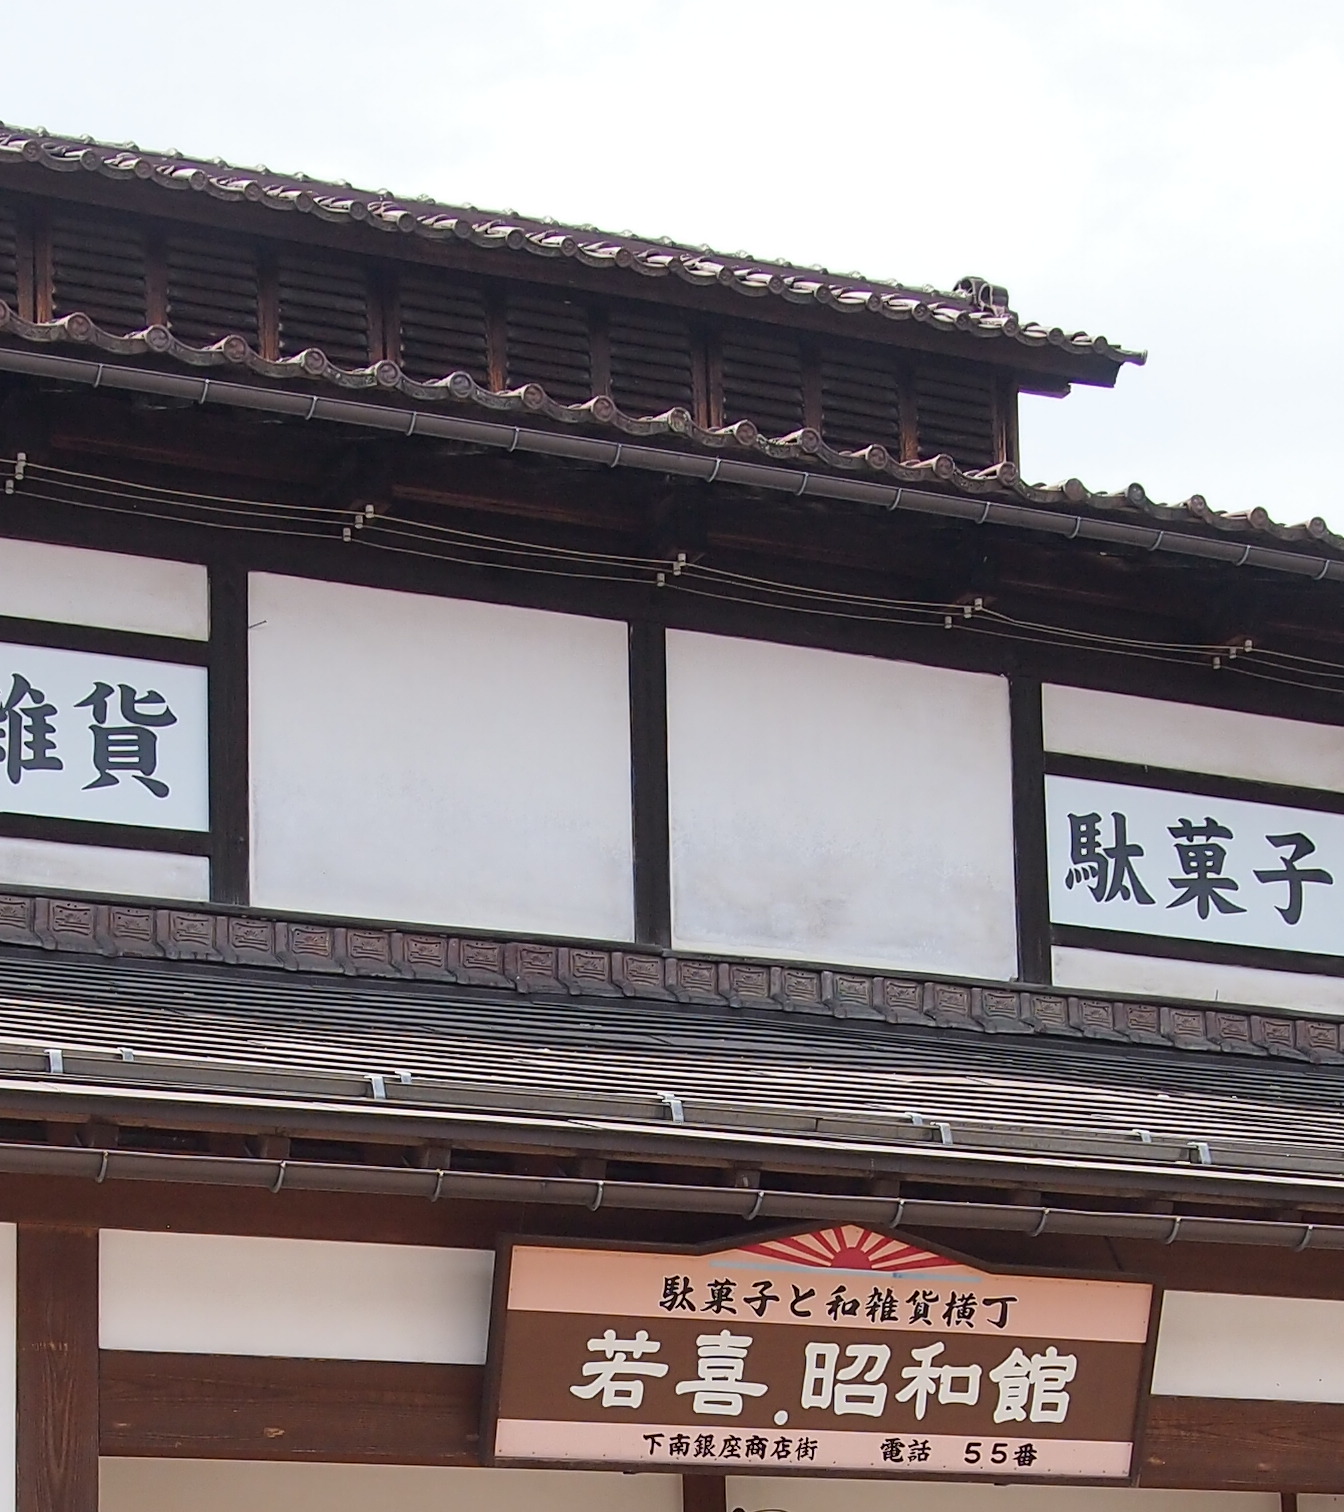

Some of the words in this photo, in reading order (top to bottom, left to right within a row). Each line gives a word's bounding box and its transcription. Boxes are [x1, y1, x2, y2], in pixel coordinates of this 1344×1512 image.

[1064, 811, 1334, 926] 駄菓子
[659, 1275, 1018, 1329] 駄菓子と和雑貨横丁
[642, 1431, 818, 1461] 下南銀座商店街
[879, 1438, 932, 1463] 電話
[963, 1441, 1039, 1467] 55番
